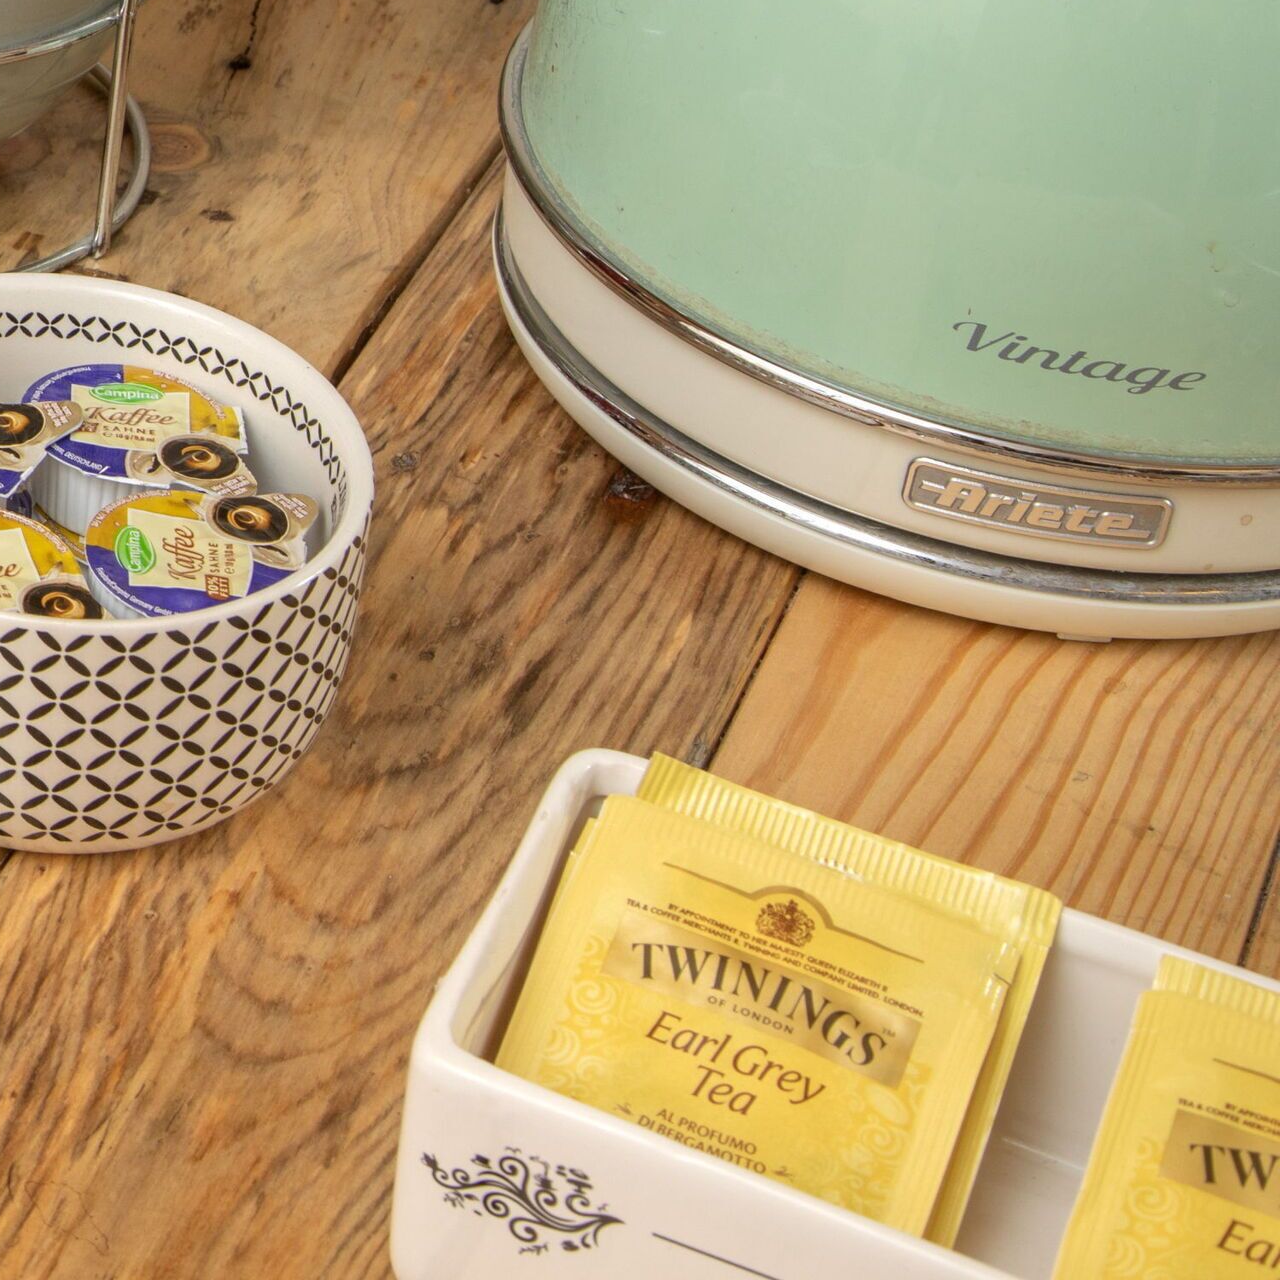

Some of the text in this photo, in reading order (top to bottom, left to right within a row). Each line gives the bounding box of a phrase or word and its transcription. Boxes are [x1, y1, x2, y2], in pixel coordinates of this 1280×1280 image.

[953, 321, 1207, 394] Vintage
[84, 406, 176, 426] Kaffee
[94, 387, 159, 400] Campina
[102, 425, 156, 435] SAHNE
[921, 477, 1151, 539] Ariete
[128, 530, 141, 572] Campina
[162, 526, 204, 580] Kaffee
[208, 542, 220, 573] SAHNE
[208, 576, 220, 596] 10%
[219, 577, 229, 598] FETT
[627, 898, 641, 908] TEA
[650, 907, 680, 922] COFFEE
[683, 918, 732, 942] MERCHANTS
[743, 942, 780, 959] TWINING
[783, 955, 801, 967] AND
[803, 963, 845, 985] COMPANY
[680, 908, 737, 934] APPOINTMENT
[752, 934, 768, 947] HER
[769, 942, 805, 959] MAJESTY
[807, 955, 837, 971] QUEEN
[838, 968, 881, 990] ELIZABETH
[632, 942, 887, 1066] TWININGS
[707, 995, 795, 1035] OF LONDON
[645, 1010, 826, 1105] Earl Grey
[691, 1065, 757, 1116] Tea
[637, 1115, 767, 1174] DI BERGAMOTTO
[656, 1108, 757, 1156] AL PROFUMO
